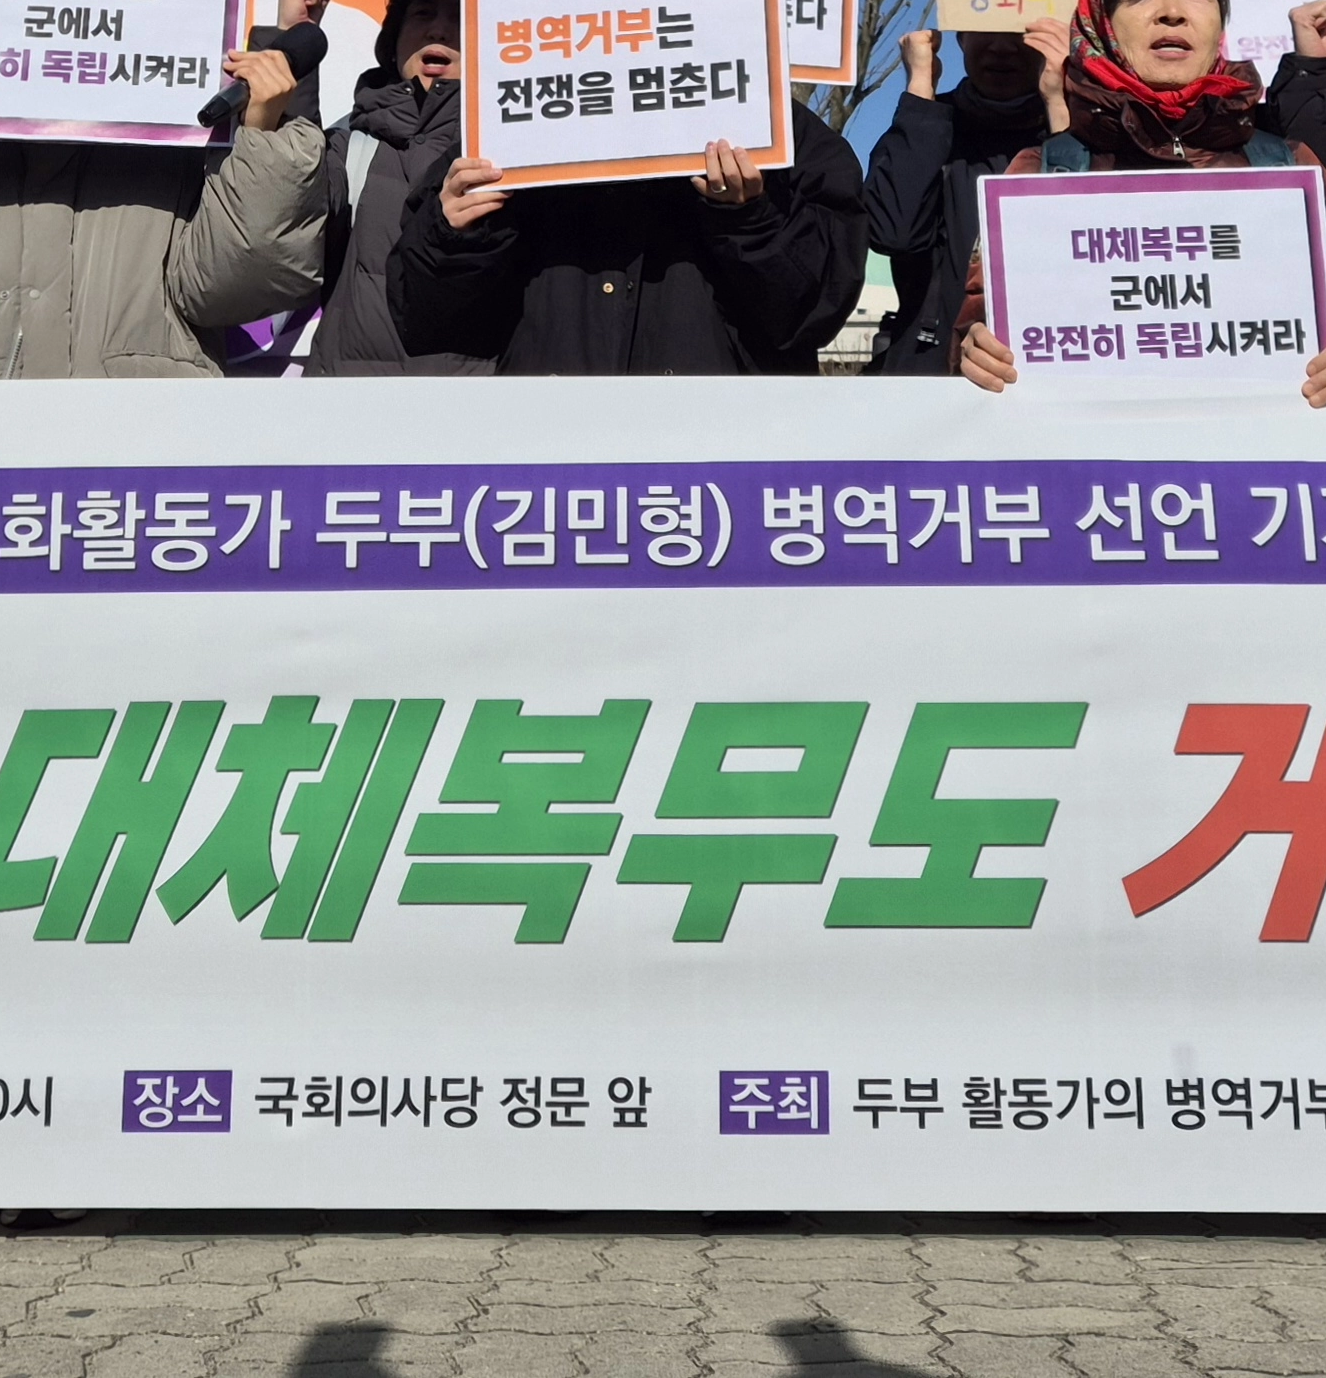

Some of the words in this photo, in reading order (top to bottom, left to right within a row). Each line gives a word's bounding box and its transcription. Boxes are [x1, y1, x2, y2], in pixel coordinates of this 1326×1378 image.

[23, 6, 124, 42] 군에서
[496, 6, 696, 65] 병역거부는
[40, 49, 210, 89] 독립시켜라
[496, 70, 615, 125] 전쟁을
[628, 57, 751, 113] 멈춘다
[1071, 224, 1241, 262] 대체복무를
[1109, 273, 1213, 311] 군에서
[1021, 325, 1127, 364] 완전히
[1135, 319, 1307, 361] 독립시켜라
[315, 482, 732, 571] 두부(김민형)
[762, 484, 1052, 565] 병역거부
[1073, 482, 1219, 563] 선언
[132, 1075, 224, 1128] 장소
[253, 1073, 484, 1129] 국회의사당
[498, 1075, 592, 1128] 정문
[607, 1075, 652, 1129] 앞
[728, 1075, 821, 1130] 주최
[853, 1077, 945, 1131] 두부
[961, 1076, 1145, 1132] 활동가의
